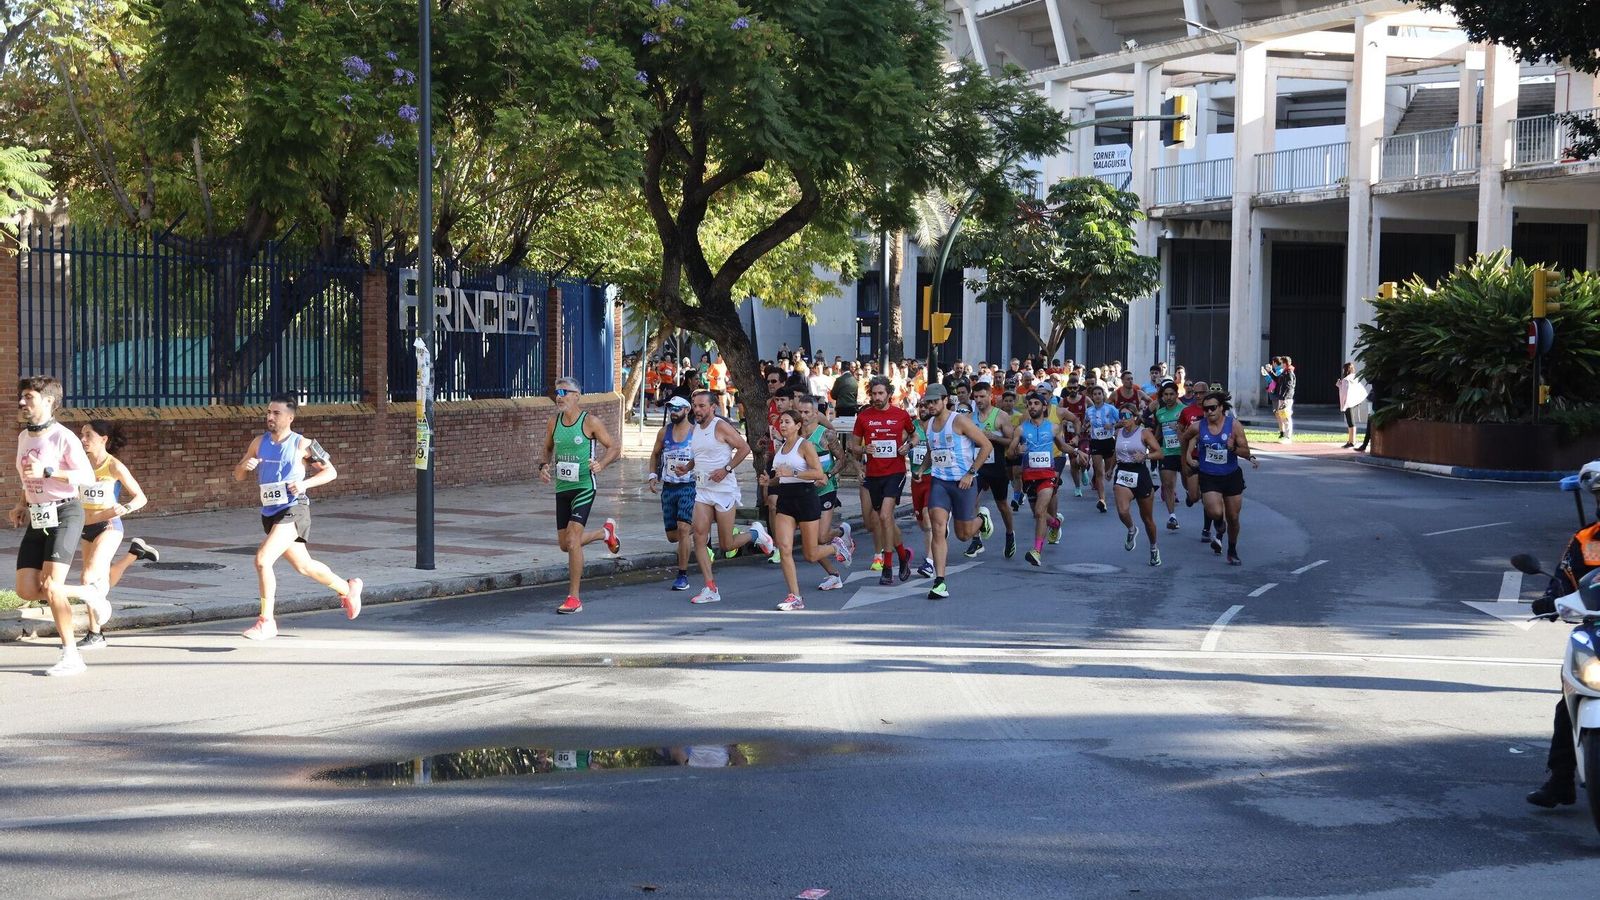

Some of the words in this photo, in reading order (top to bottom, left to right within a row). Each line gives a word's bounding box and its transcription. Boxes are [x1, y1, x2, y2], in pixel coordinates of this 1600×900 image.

[1093, 151, 1115, 160] CORNER
[1093, 159, 1126, 169] MALAGUISTA
[1208, 452, 1224, 460] 752
[560, 468, 572, 476] 90
[1120, 475, 1134, 483] 464
[83, 489, 105, 498] 409
[263, 490, 282, 499] 448
[32, 511, 50, 521] 324
